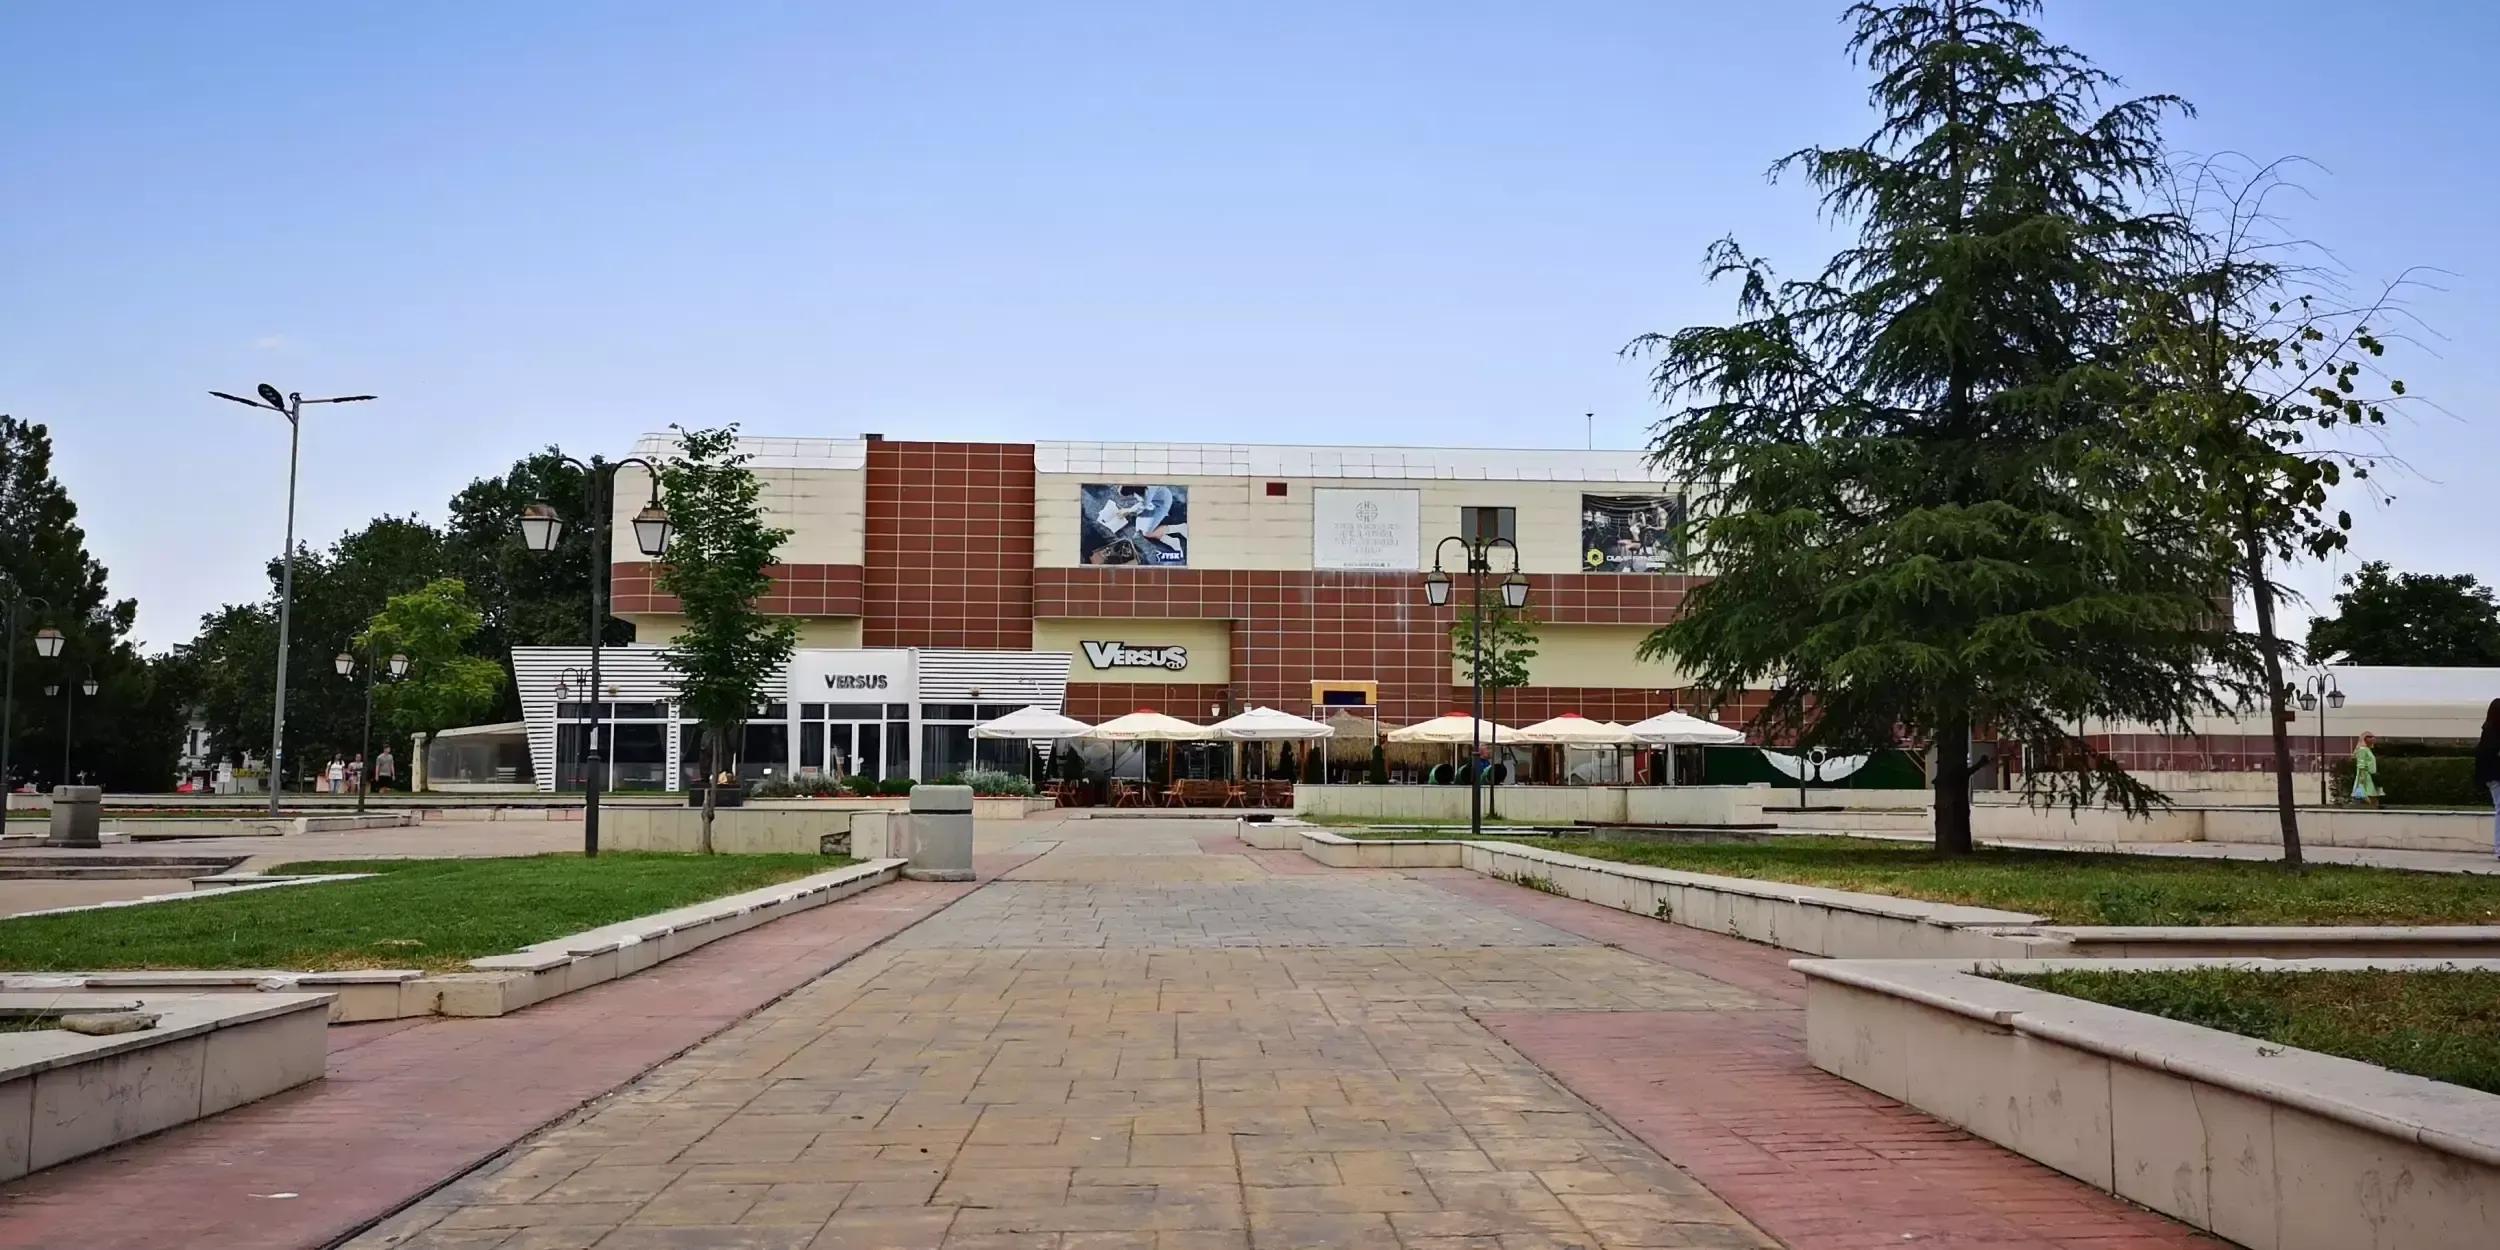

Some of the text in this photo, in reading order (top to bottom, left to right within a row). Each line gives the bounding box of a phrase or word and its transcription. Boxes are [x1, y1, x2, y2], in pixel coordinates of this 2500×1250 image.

[1161, 552, 1180, 560] JYSK
[1080, 641, 1187, 669] VERSUS
[824, 674, 888, 689] VERSUS
